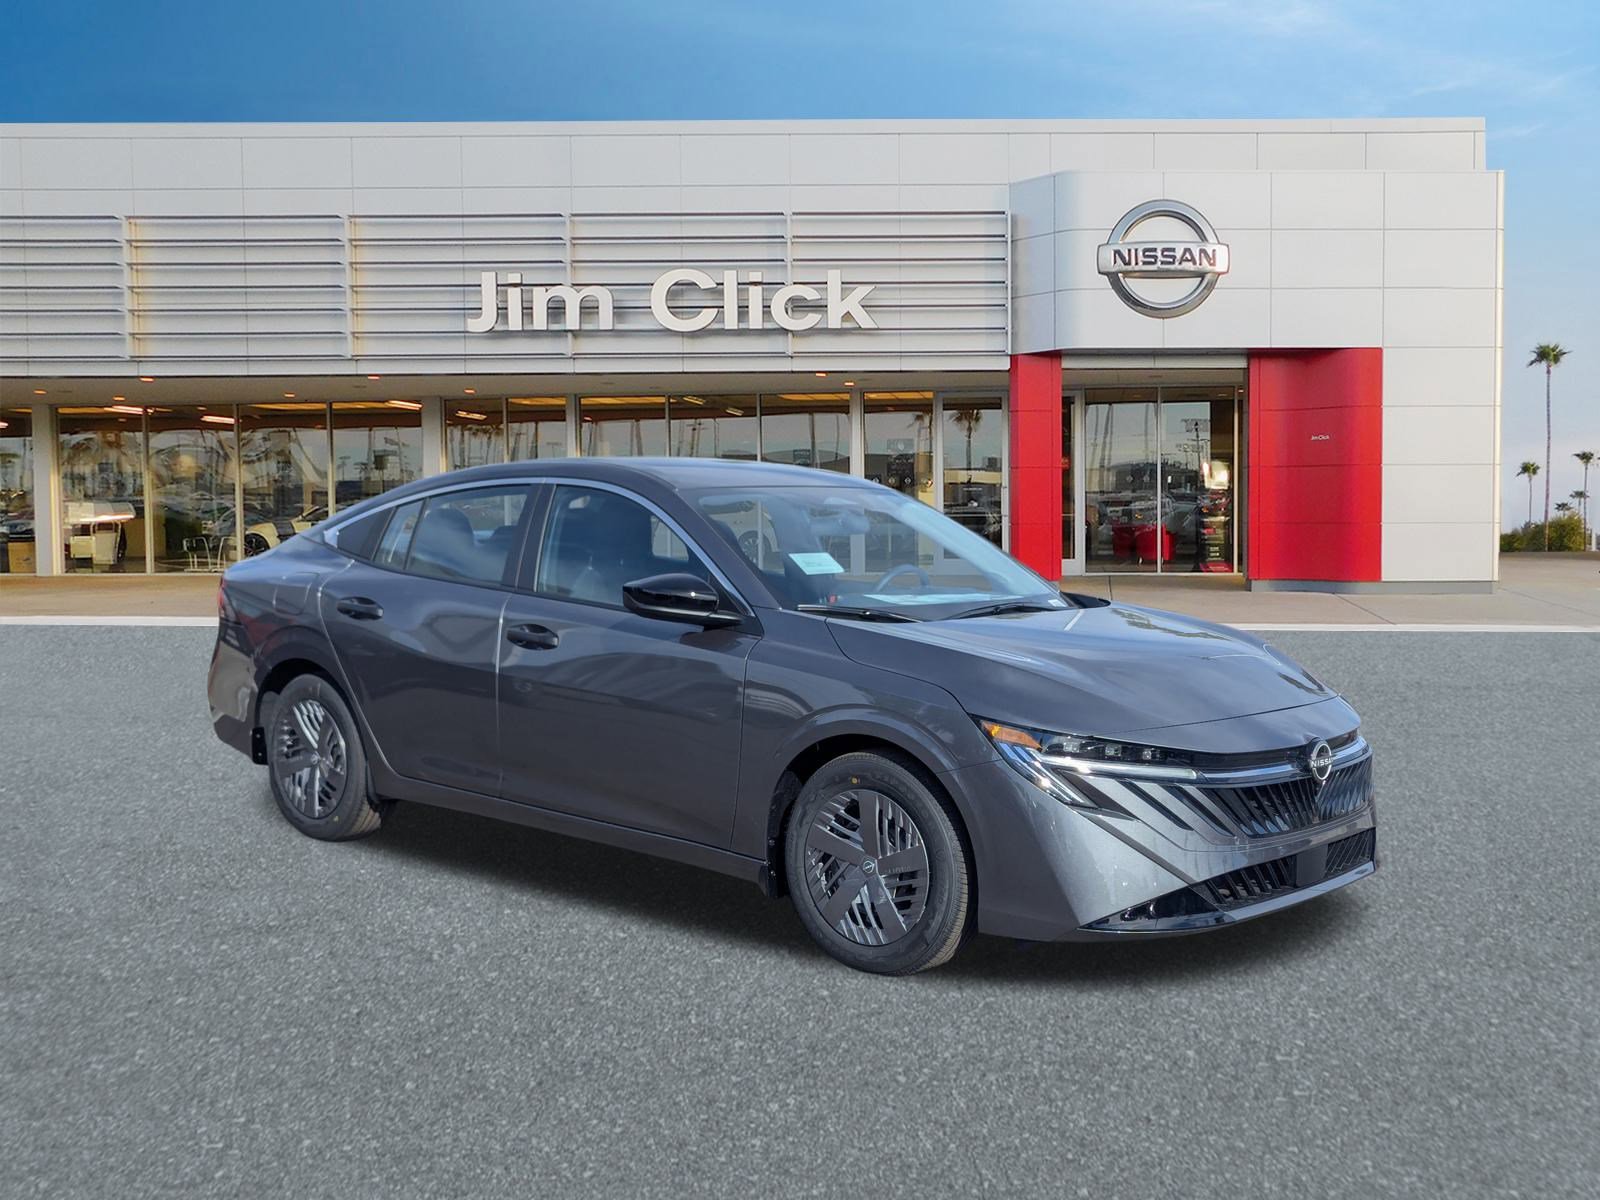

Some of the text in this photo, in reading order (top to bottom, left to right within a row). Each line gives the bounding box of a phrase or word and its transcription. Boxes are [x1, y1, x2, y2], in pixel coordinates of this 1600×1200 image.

[1113, 247, 1217, 267] NISSAN
[466, 268, 879, 333] Jim Click
